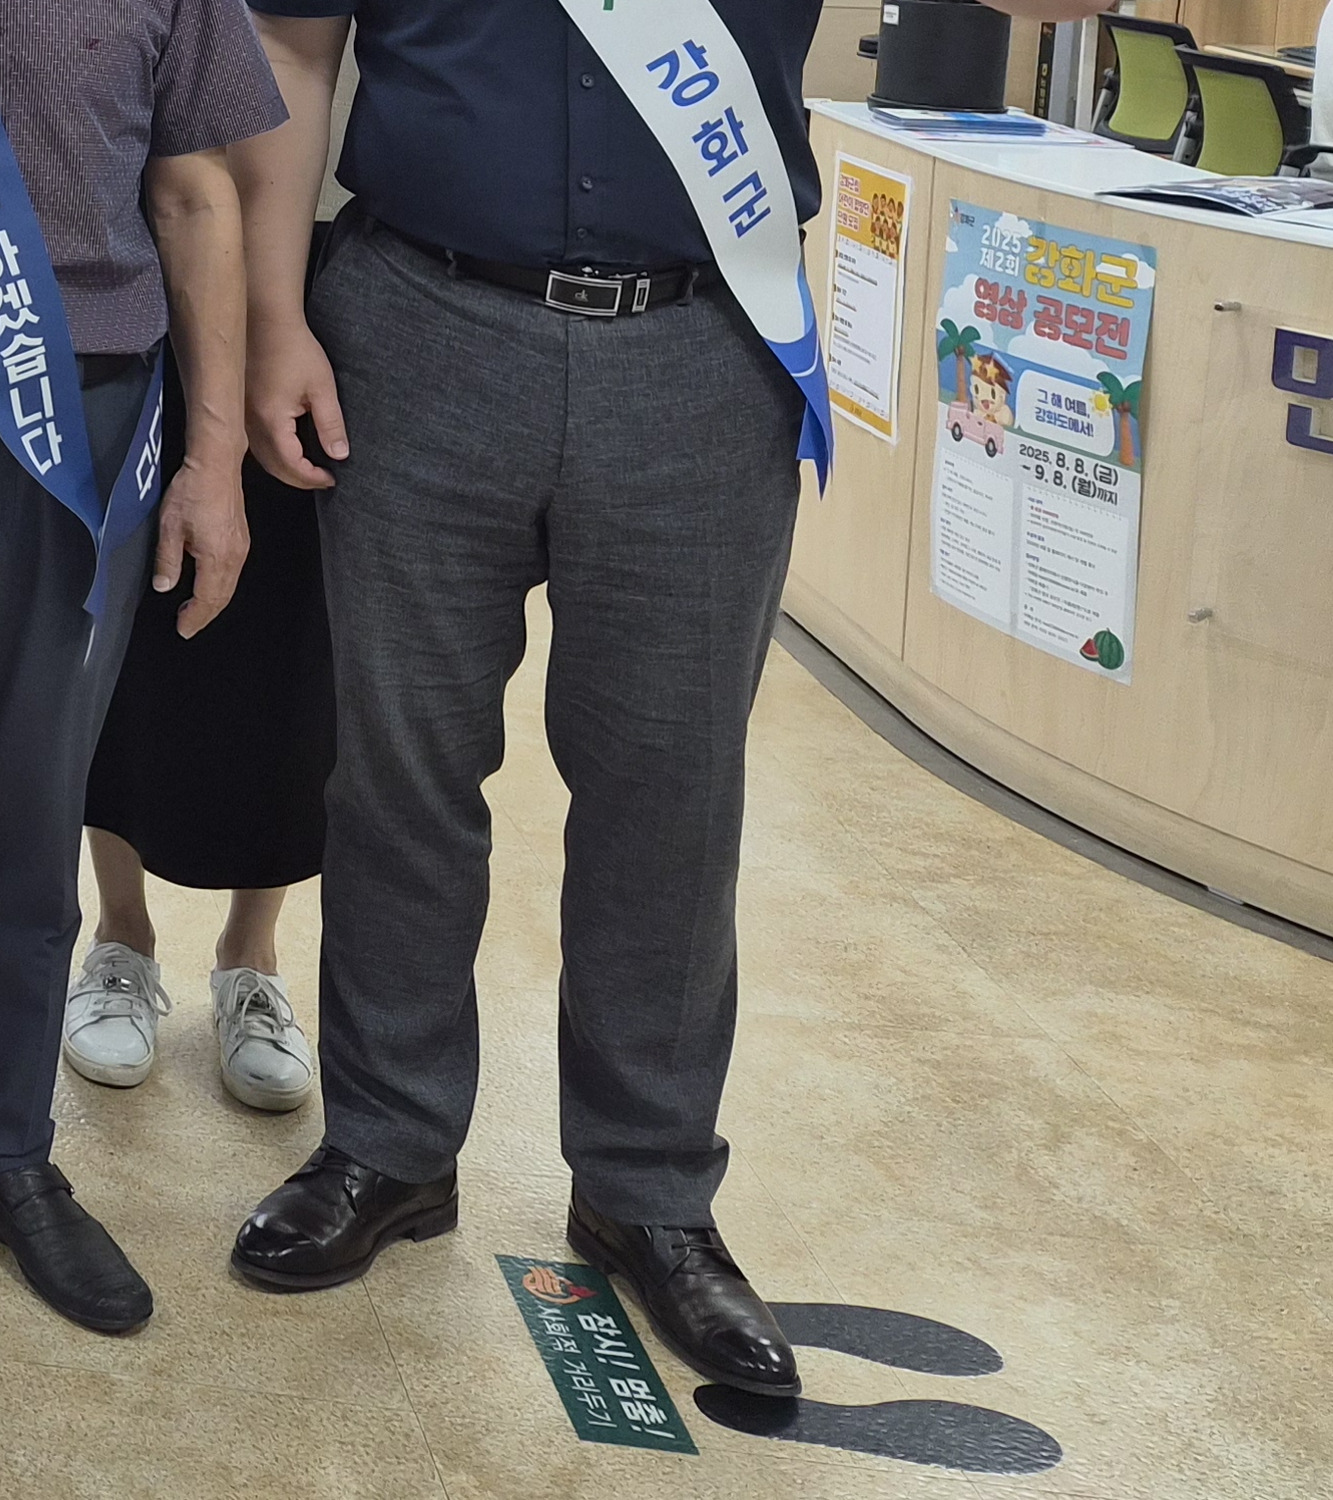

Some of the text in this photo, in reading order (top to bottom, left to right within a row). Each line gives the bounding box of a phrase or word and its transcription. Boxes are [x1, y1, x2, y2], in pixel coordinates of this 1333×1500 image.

[644, 38, 773, 240] 강화군
[981, 224, 1022, 254] 2025
[979, 235, 1138, 309] 제2회 강화군
[974, 277, 1130, 360] 영상 공모전
[1035, 406, 1094, 438] 강화도에서!
[1037, 388, 1090, 419] 그 해 여름,
[1019, 443, 1118, 487] 2025. 8. 8. (금)
[1035, 464, 1049, 483] 9.
[1052, 470, 1067, 489] 8.
[537, 1304, 618, 1428] 사회적 거리두기
[577, 1312, 676, 1439] 잠시! 멈춤!
